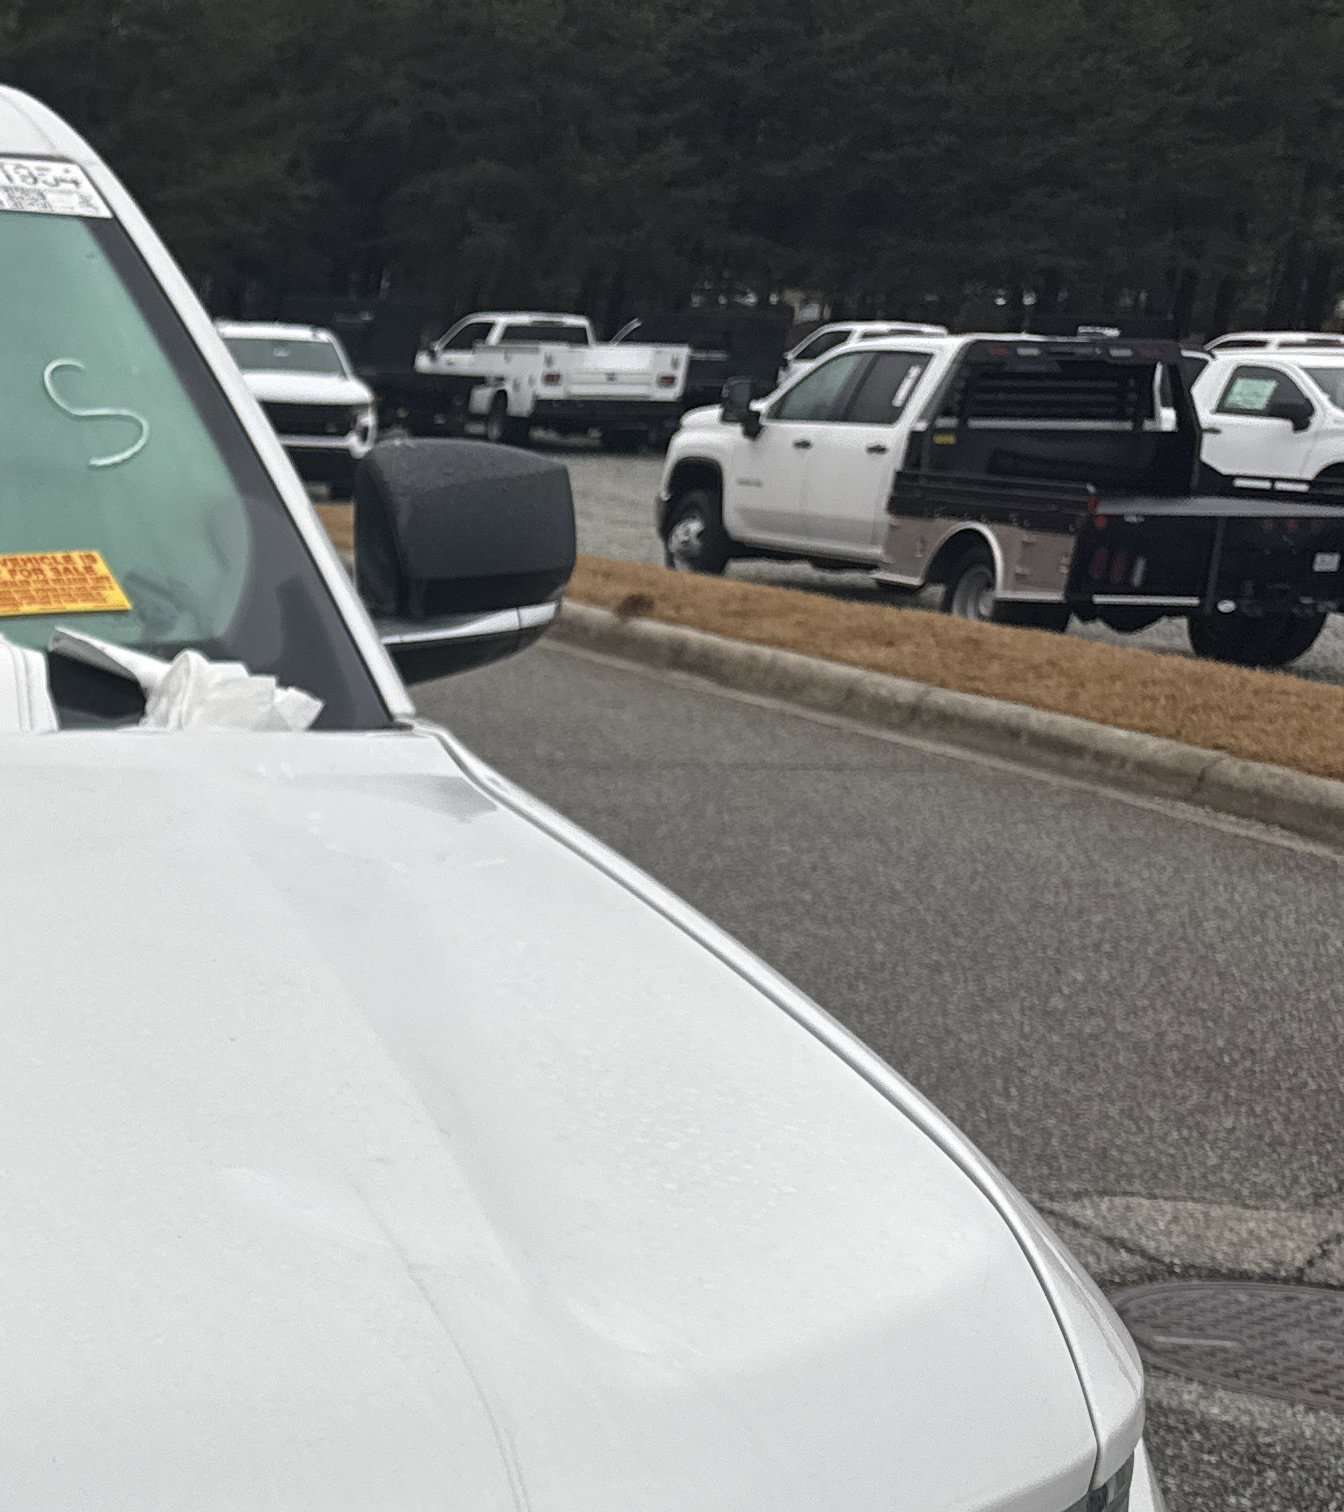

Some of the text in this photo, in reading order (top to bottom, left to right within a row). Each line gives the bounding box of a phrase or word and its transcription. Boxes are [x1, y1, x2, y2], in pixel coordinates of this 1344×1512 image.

[43, 358, 150, 467] S
[0, 555, 77, 569] VEHICLE
[9, 567, 46, 580] FOR
[50, 565, 98, 578] SALE
